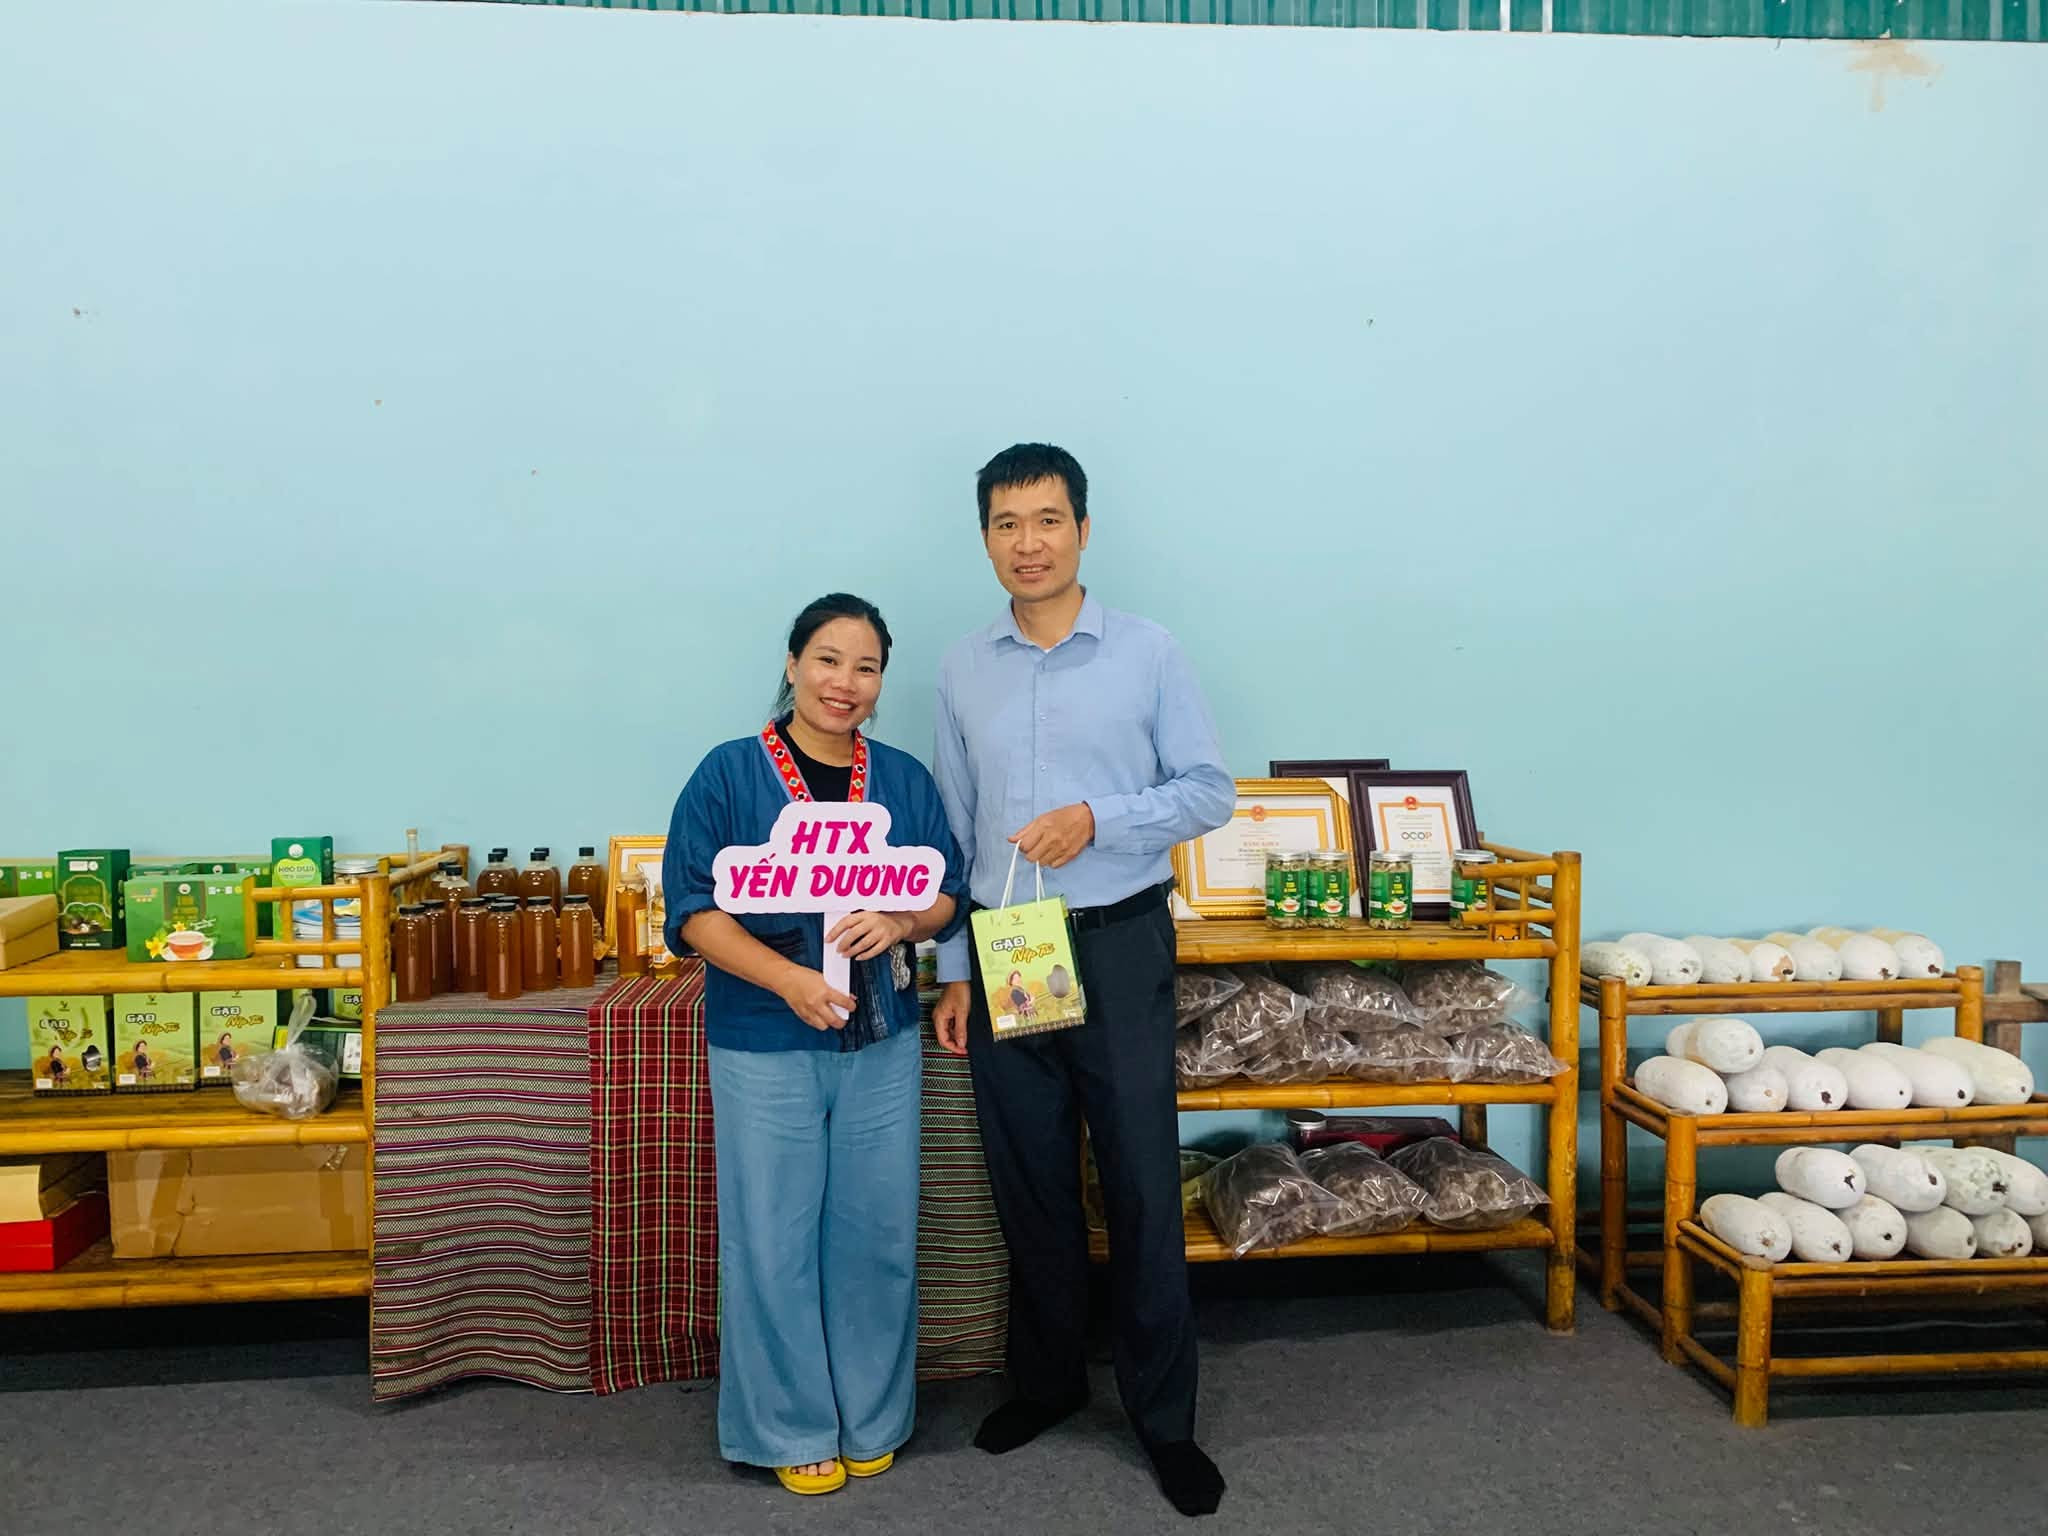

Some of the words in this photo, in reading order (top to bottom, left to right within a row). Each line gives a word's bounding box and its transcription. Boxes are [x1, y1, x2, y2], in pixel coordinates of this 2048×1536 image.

[791, 821, 873, 854] HTX
[1401, 831, 1433, 840] OCOP
[729, 853, 799, 898] YẾN
[810, 864, 930, 897] DƯƠNG
